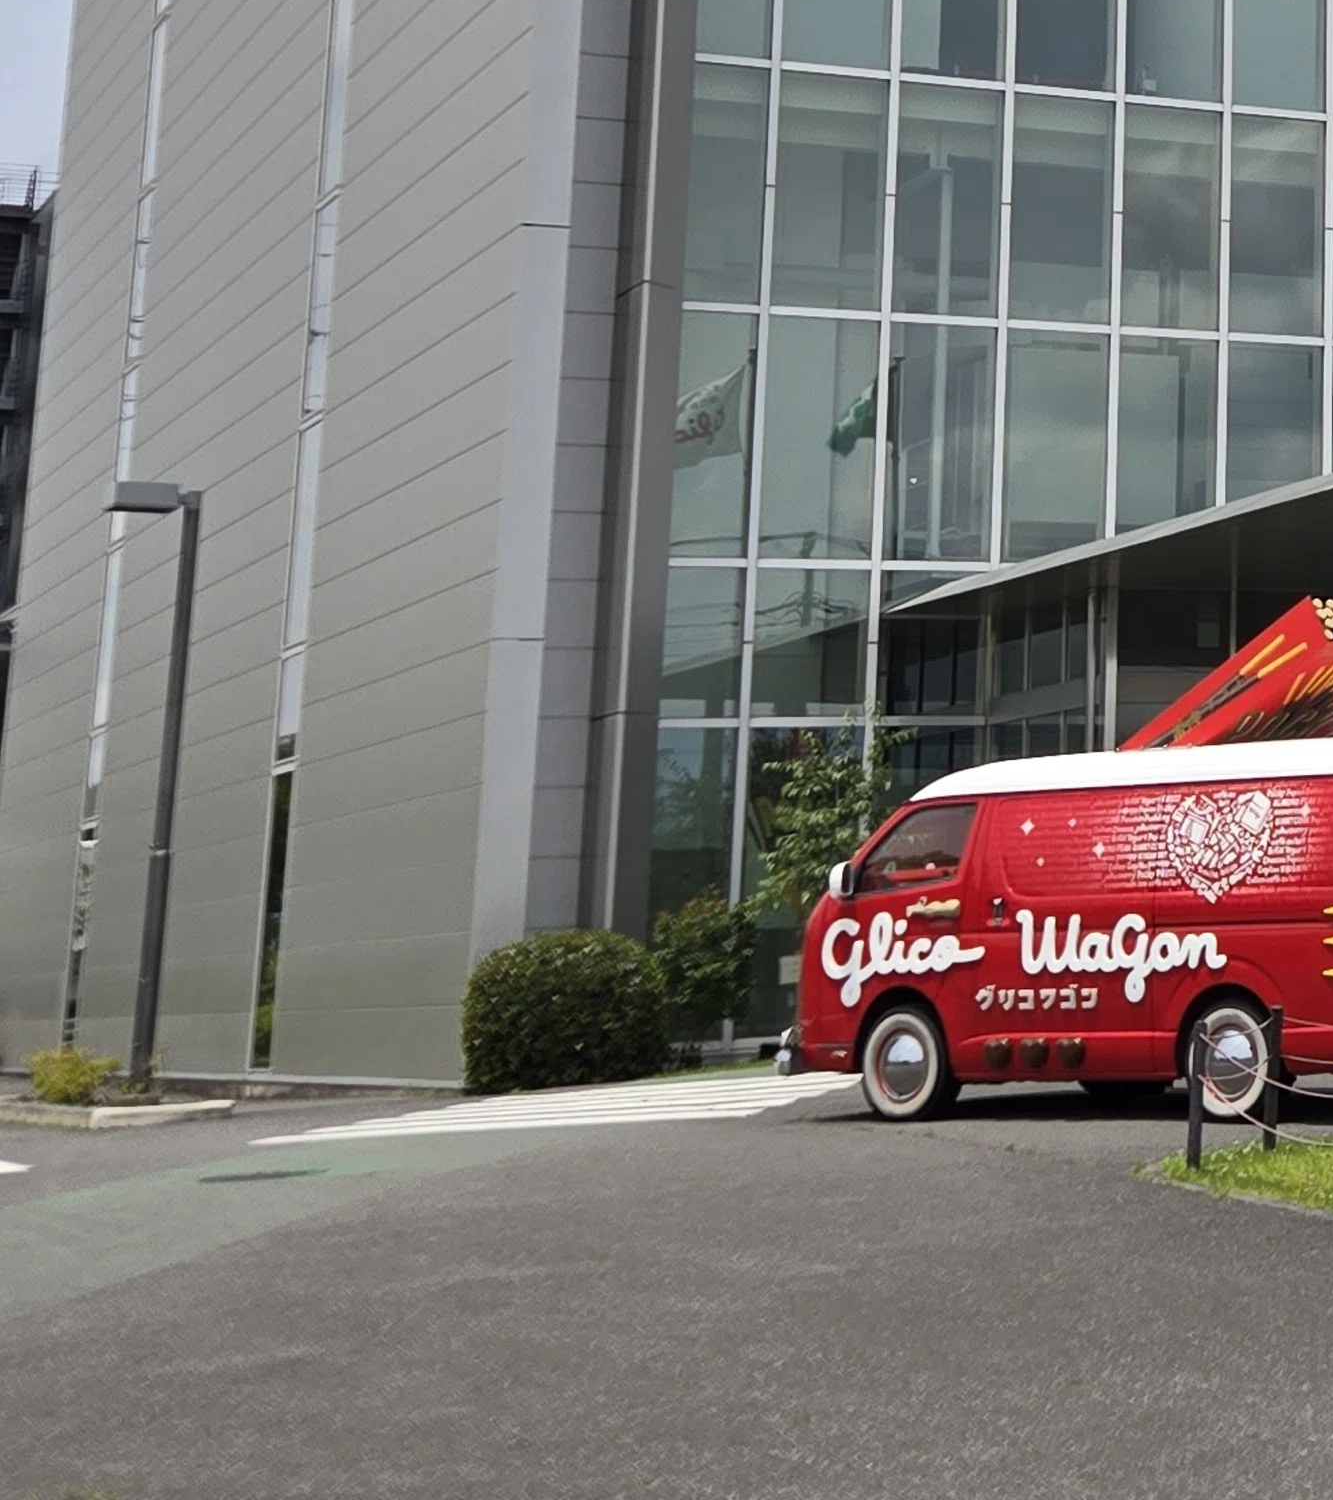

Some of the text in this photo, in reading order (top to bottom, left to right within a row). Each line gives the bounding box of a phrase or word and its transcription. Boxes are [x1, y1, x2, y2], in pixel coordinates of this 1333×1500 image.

[821, 909, 1228, 1008] Glico WaGon
[975, 983, 1099, 1011] グリコワゴン
